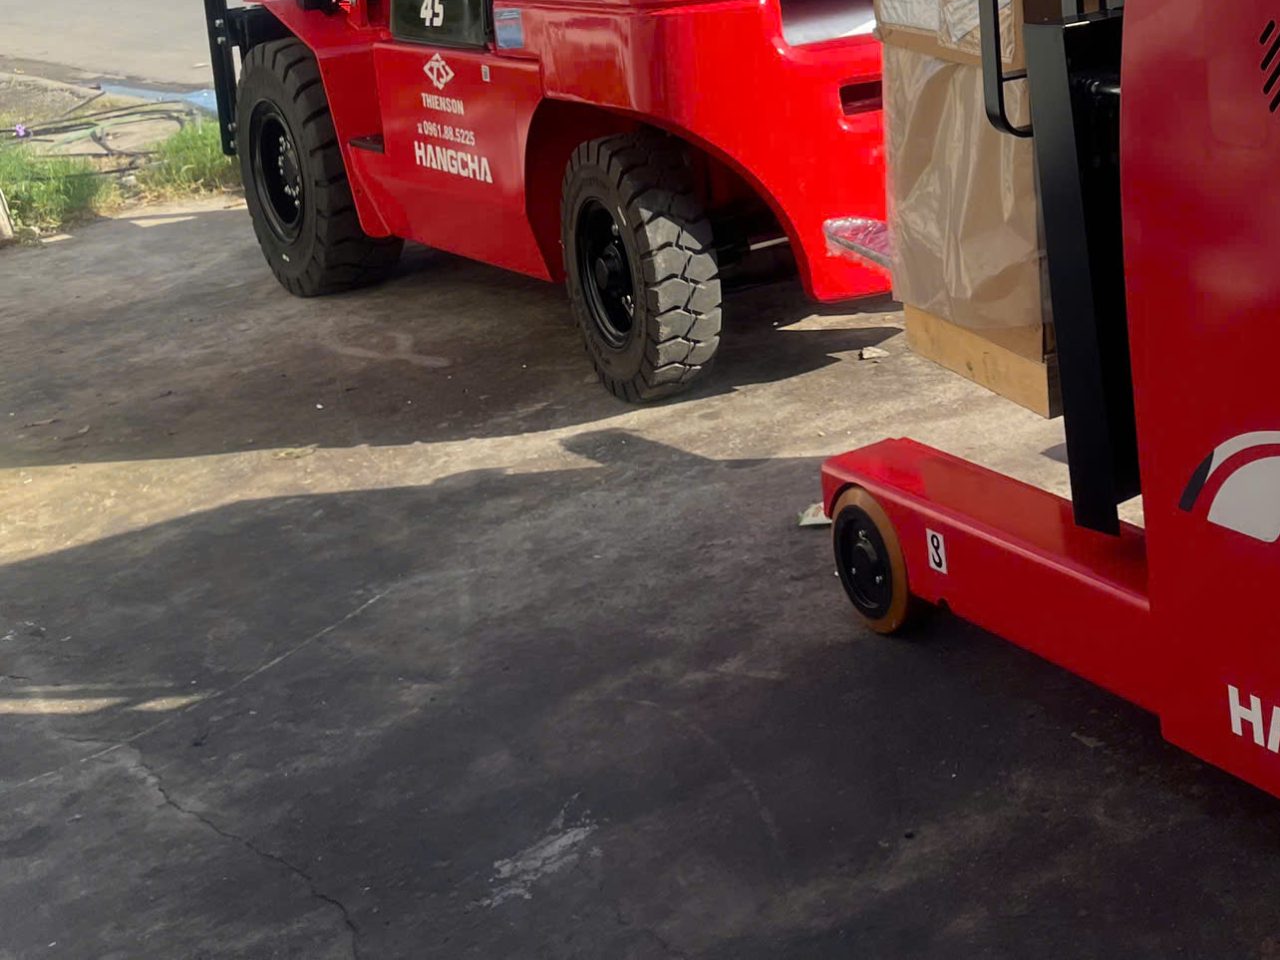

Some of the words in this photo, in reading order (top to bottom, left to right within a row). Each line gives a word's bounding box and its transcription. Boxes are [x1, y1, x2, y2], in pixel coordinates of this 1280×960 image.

[421, 93, 465, 116] THIENSON
[423, 120, 476, 146] 0961.88.5225
[414, 141, 494, 184] HANGCHA
